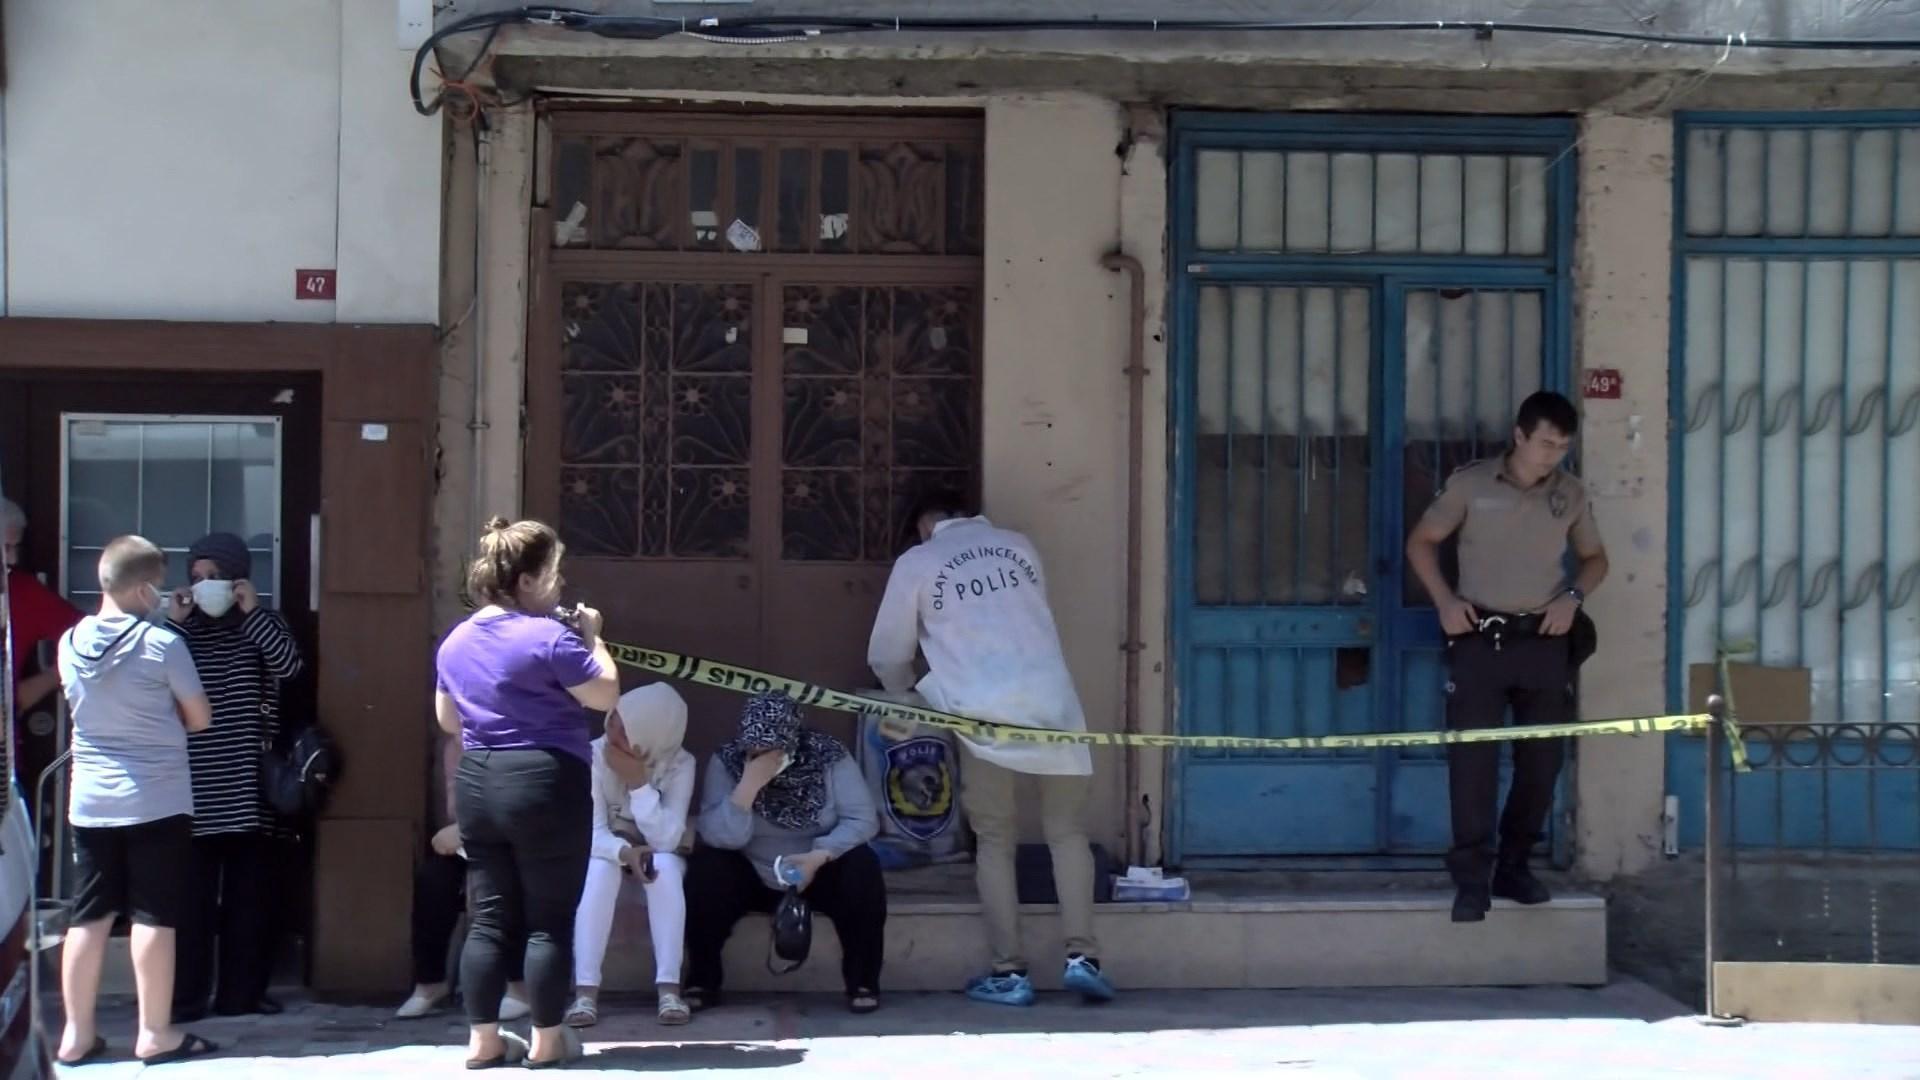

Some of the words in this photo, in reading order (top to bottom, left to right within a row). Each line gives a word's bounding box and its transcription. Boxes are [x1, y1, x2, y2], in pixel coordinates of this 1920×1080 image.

[306, 276, 326, 293] 47
[932, 570, 948, 610] OLAY
[954, 566, 1020, 600] POLİS
